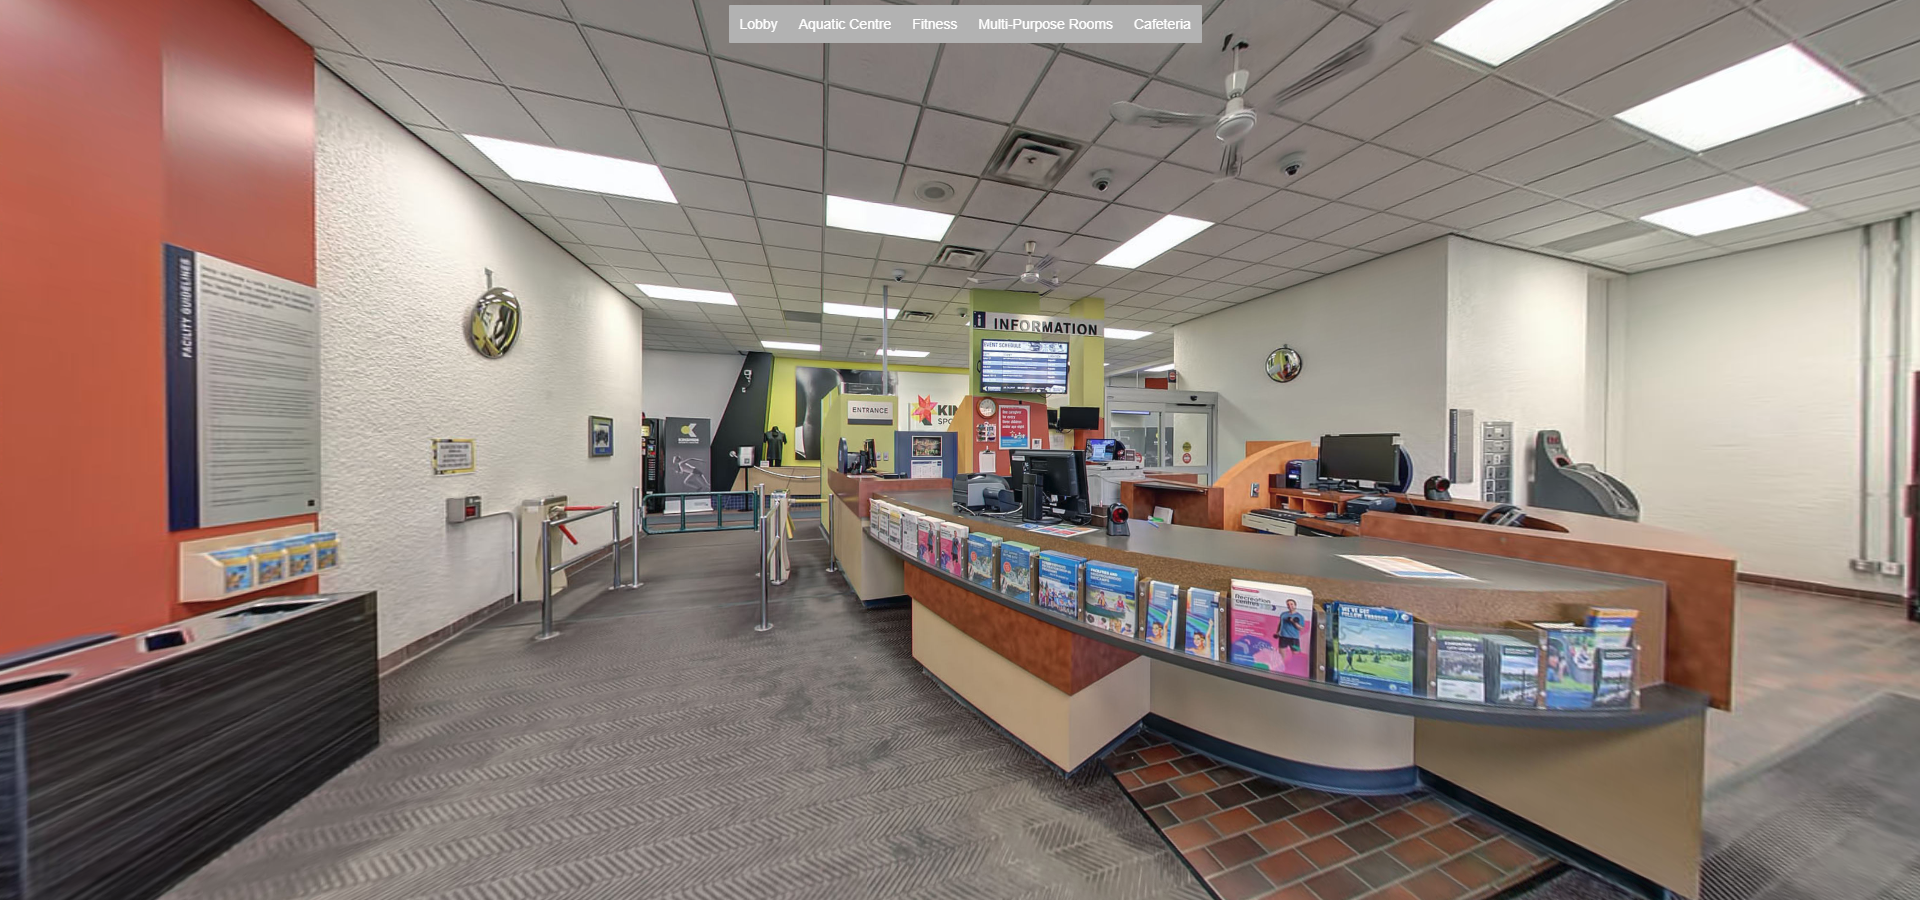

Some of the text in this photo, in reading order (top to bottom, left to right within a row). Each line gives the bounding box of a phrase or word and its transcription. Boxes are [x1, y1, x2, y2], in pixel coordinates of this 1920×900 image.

[180, 258, 193, 358] FACILITY GUIDELINES
[994, 318, 1098, 335] INFORMATION
[1235, 594, 1271, 604] Recreation
